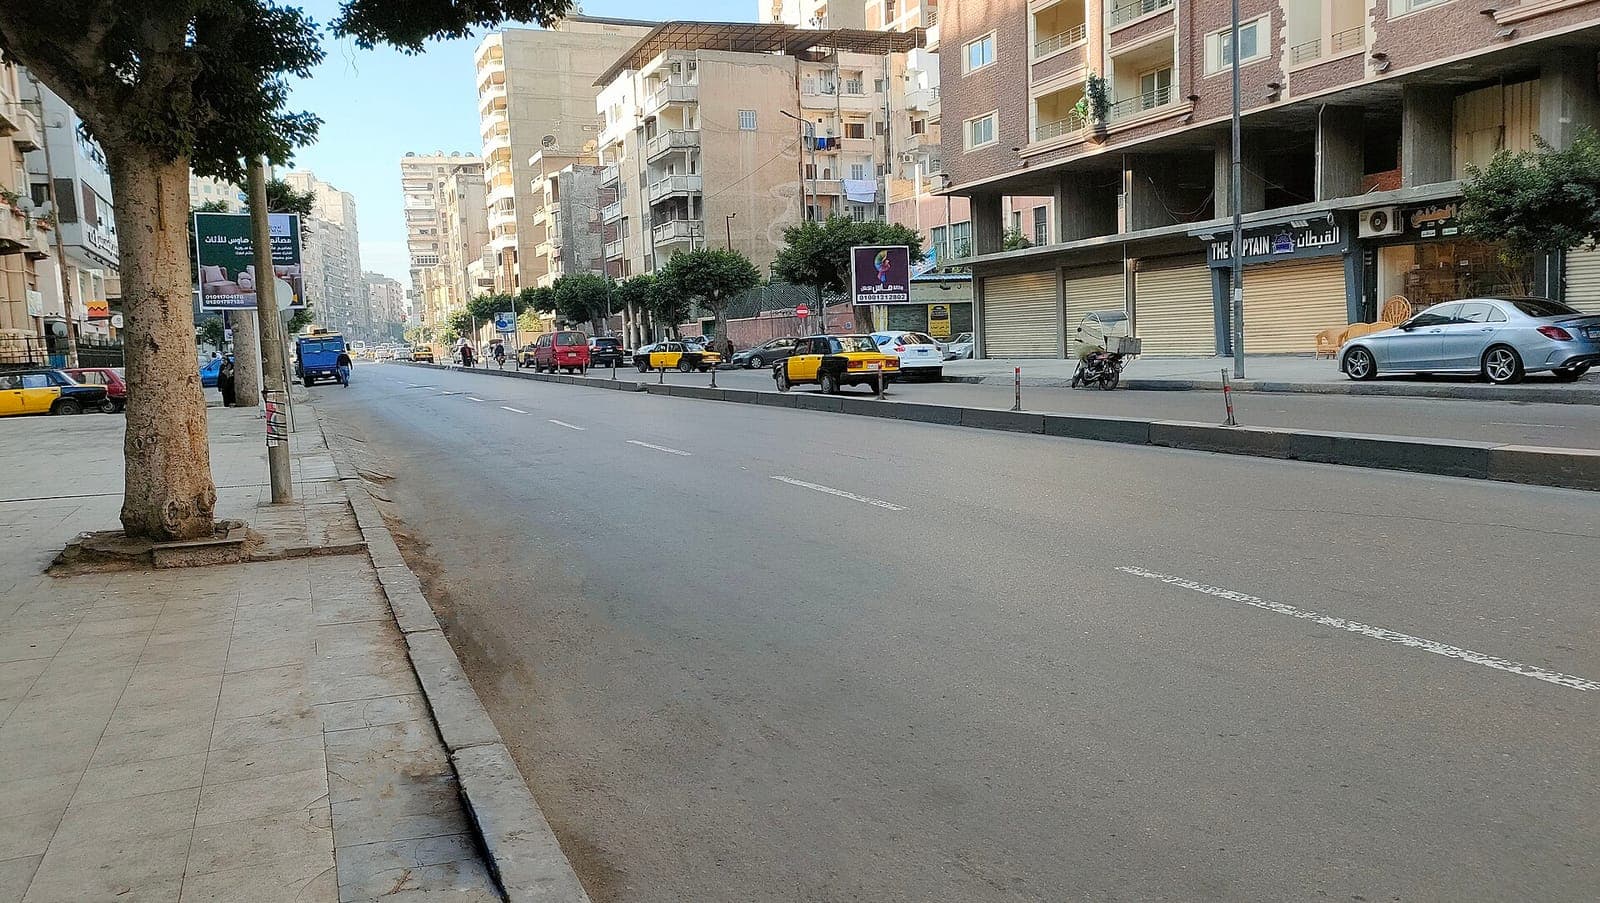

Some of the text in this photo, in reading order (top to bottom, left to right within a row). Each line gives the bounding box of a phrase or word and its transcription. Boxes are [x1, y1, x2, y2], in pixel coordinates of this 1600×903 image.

[1211, 236, 1270, 260] THE CPTAIN
[1297, 226, 1340, 249] القبطان
